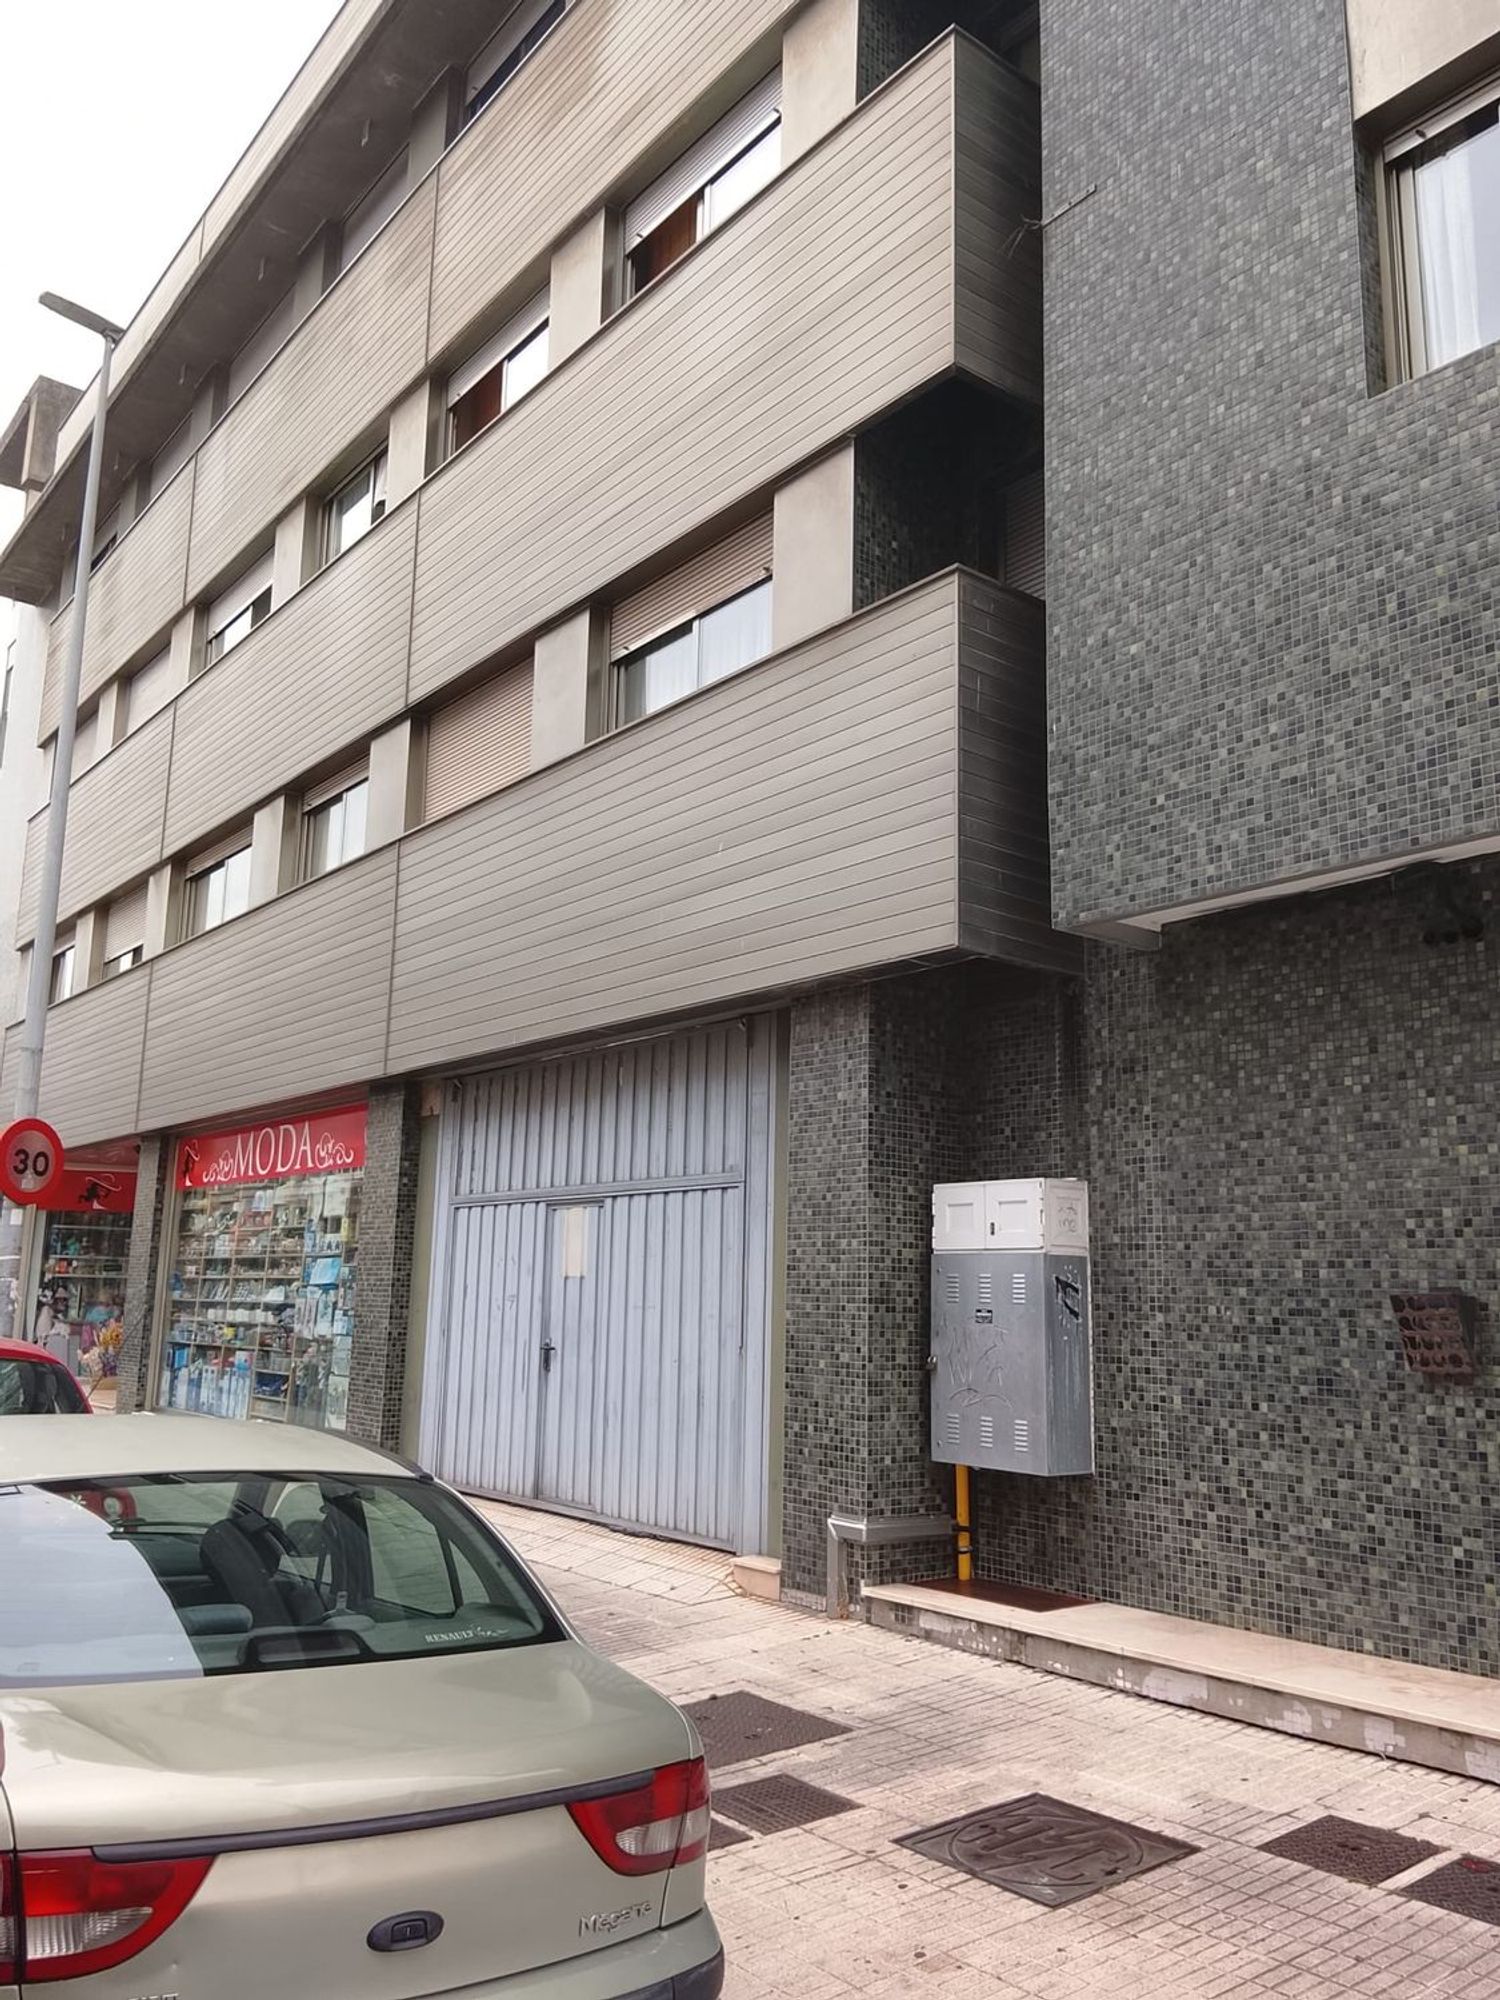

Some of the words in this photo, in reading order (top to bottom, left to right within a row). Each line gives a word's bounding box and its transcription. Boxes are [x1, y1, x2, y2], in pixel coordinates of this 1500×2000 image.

[13, 1148, 49, 1177] 30
[232, 1120, 314, 1178] MODA
[424, 1629, 474, 1643] RENAULT
